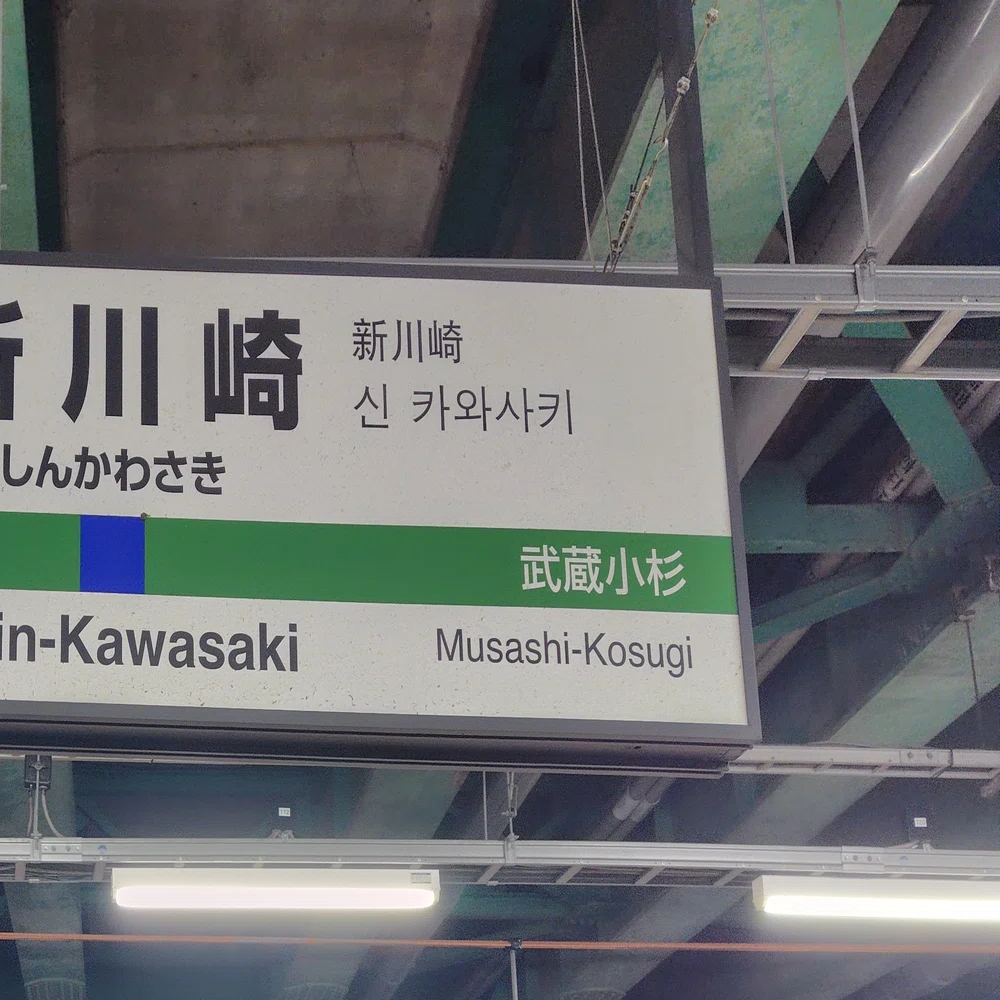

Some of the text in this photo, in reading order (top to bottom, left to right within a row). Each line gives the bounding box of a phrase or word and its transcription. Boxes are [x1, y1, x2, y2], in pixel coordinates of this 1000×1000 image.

[352, 317, 464, 364] 新川崎
[353, 383, 573, 435] 신 카와사키
[2, 444, 227, 496] しんかわさき
[520, 544, 687, 598] 武蔵小杉
[436, 627, 694, 679] Musashi-Kosugi
